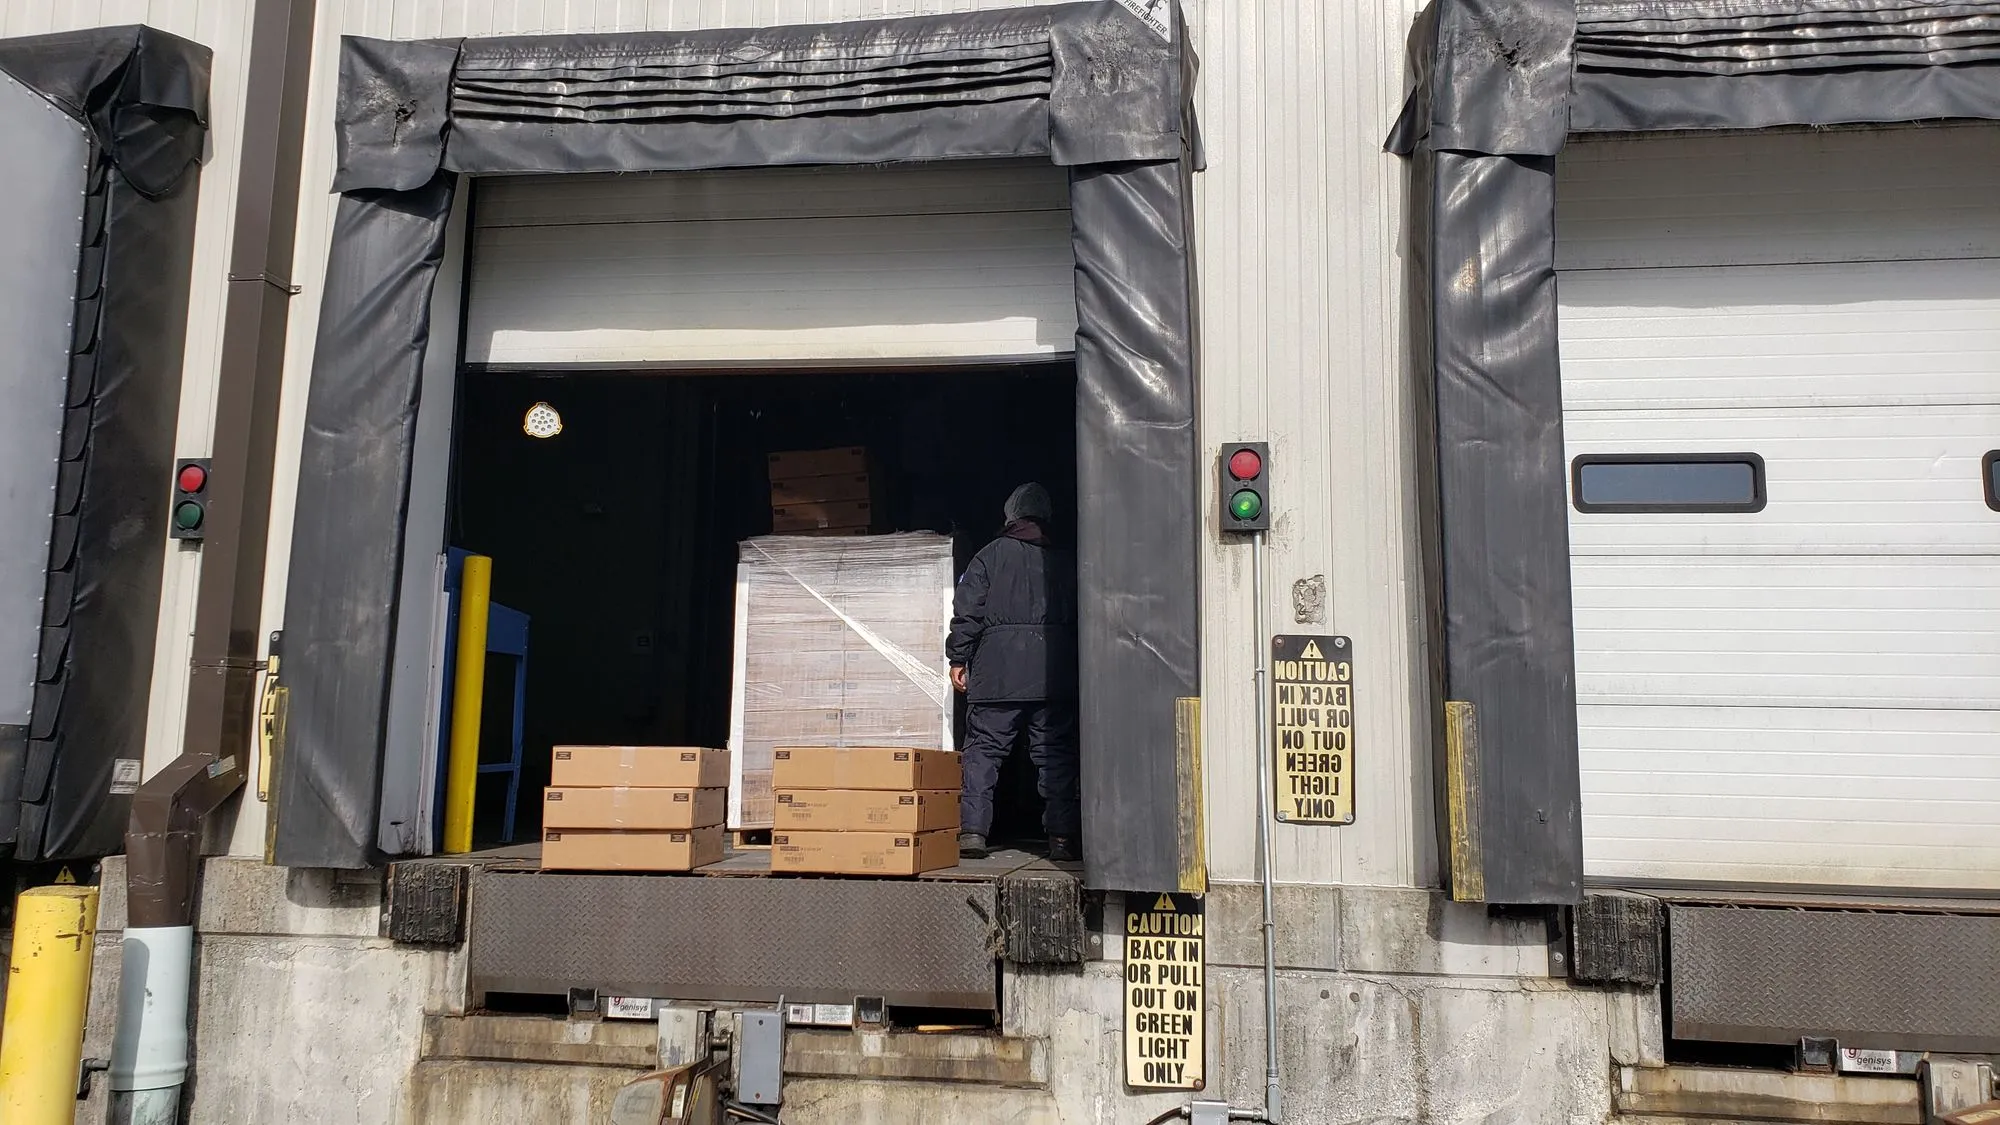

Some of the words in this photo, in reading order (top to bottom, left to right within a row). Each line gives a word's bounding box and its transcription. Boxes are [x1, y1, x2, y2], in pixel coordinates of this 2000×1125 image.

[1124, 0, 1167, 34] FIREFIGHTER
[1127, 912, 1203, 936] CAUTION
[1130, 939, 1177, 962] BACK
[1182, 941, 1199, 962] IN
[1127, 963, 1151, 984] OR
[1158, 964, 1201, 987] PULL
[620, 1004, 648, 1012] genisys
[1131, 987, 1167, 1009] OUT
[1174, 989, 1197, 1012] ON
[1135, 1012, 1193, 1035] GREEN
[1138, 1036, 1190, 1060] LIGHT
[1143, 1061, 1185, 1085] ONLY
[1856, 1056, 1892, 1066] genisys
